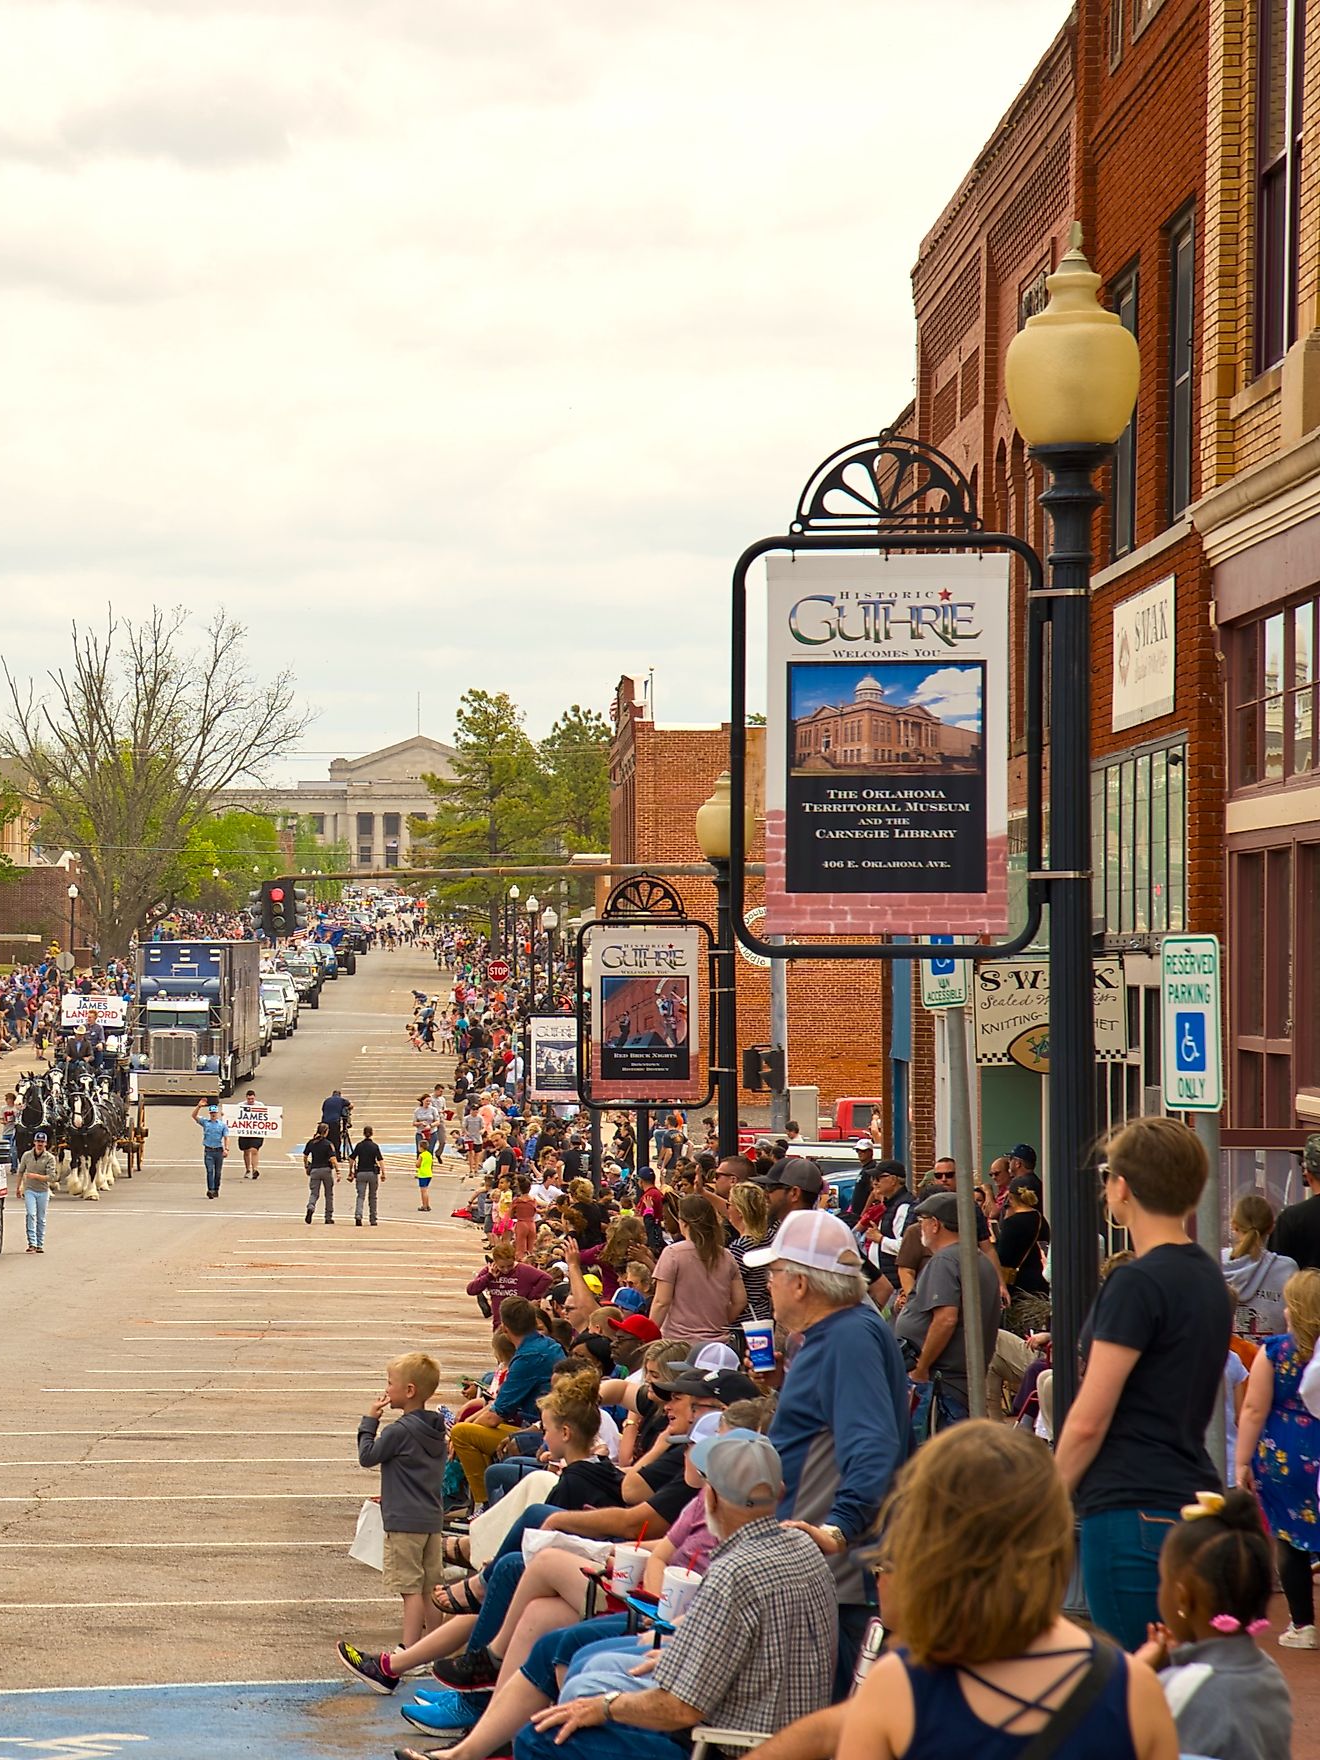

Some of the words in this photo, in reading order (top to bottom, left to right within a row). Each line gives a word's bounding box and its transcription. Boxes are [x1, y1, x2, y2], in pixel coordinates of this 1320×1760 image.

[840, 591, 934, 600] HISTORIC
[789, 594, 983, 647] GUTHRIE
[832, 650, 909, 658] WELCOMES
[914, 649, 941, 658] YOU
[827, 789, 858, 799] THE
[862, 789, 946, 799] OKLAHOMA
[802, 803, 901, 812] TERRITORIAL
[905, 802, 970, 812] MUSEUM
[815, 829, 890, 839] CARNEGIE
[894, 829, 957, 839] LIBRARY
[822, 860, 845, 868] 406
[847, 860, 859, 868] E.
[861, 860, 923, 868] OKLAHOMA
[925, 860, 951, 868] AVE.
[601, 945, 687, 970] GUTHRIE
[1166, 954, 1215, 975] RESERVED
[489, 967, 508, 975] STOP
[938, 978, 950, 988] VAN
[927, 989, 963, 1002] ACCESSIBLE
[1168, 983, 1211, 1004] PARKING
[77, 1000, 108, 1009] JAMES
[981, 994, 1033, 1010] Sealed
[66, 1010, 118, 1019] LANORD
[1178, 1078, 1206, 1099] ONLY
[238, 1110, 269, 1121] JAMES
[226, 1120, 279, 1130] LANKFORD
